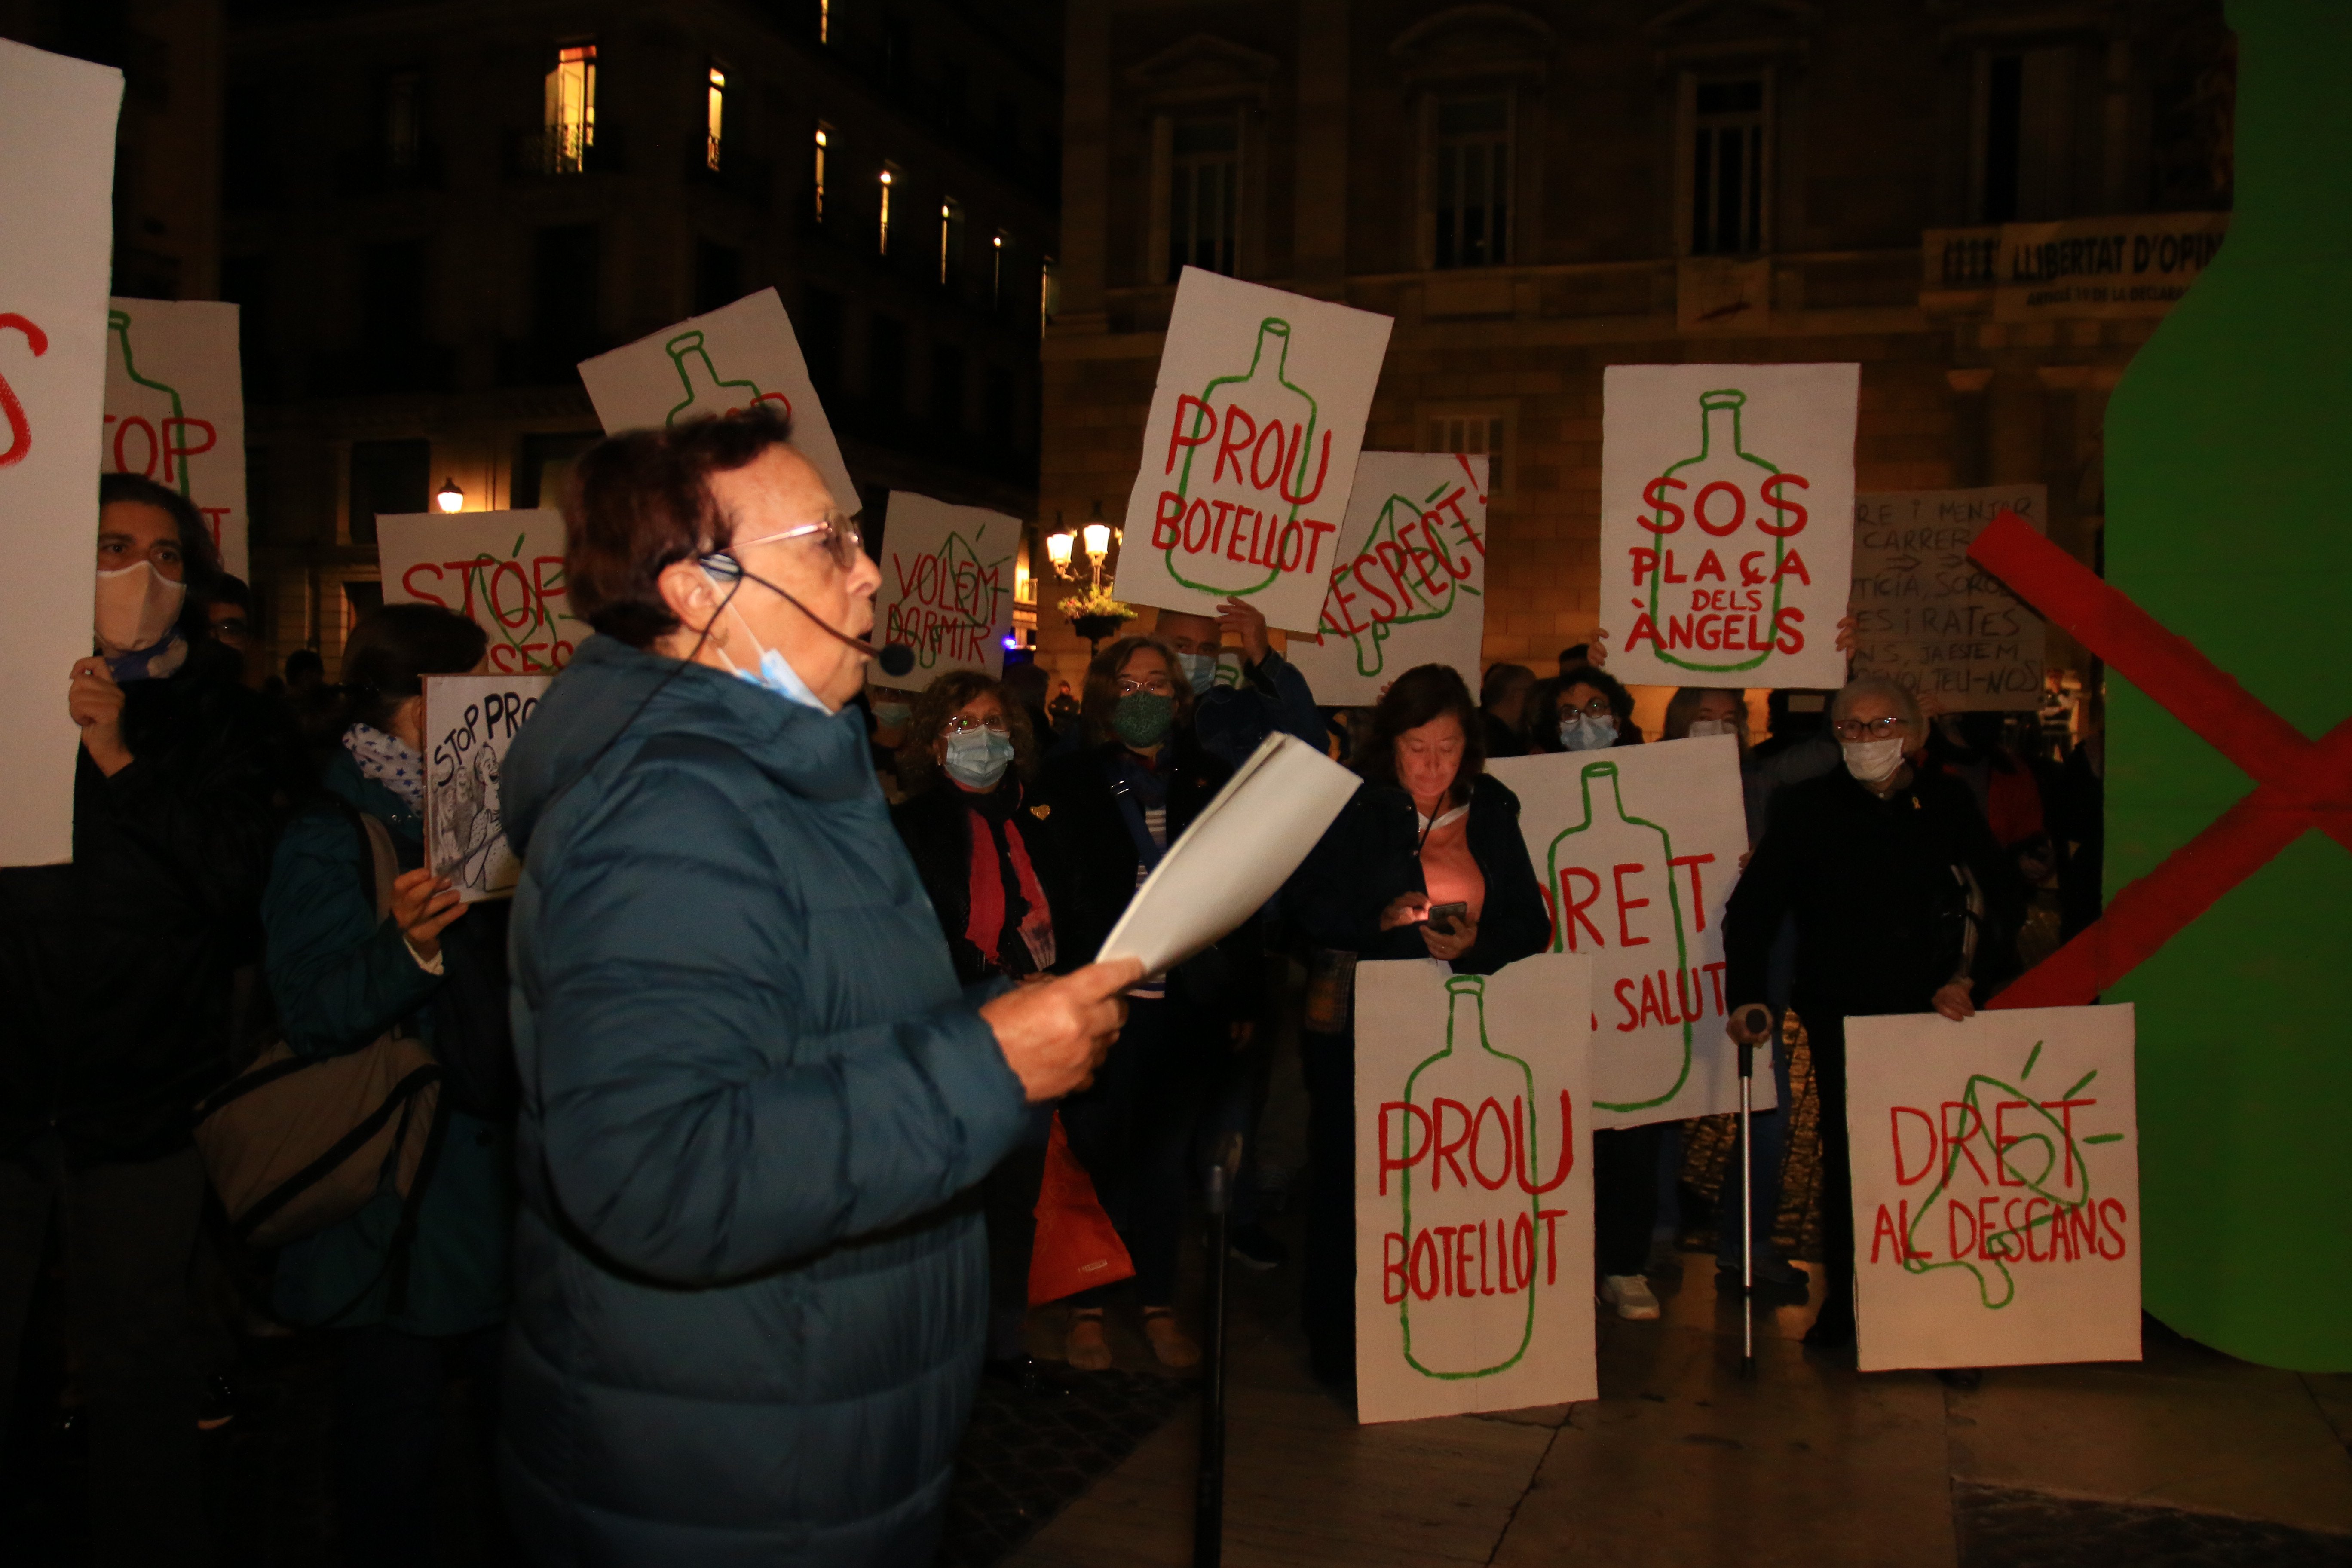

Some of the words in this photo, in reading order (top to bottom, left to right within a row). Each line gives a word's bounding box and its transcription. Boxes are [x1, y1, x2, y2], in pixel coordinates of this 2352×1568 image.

[2013, 236, 2127, 280] LLIBERTAT
[1165, 394, 1332, 505] PROU
[1152, 491, 1336, 573] BOTELLOT
[1637, 473, 1810, 537] SOS
[893, 553, 999, 625] VOLEM
[1629, 547, 1811, 587] PLAÇA
[1691, 589, 1763, 612] DELS
[885, 603, 991, 664] DORMIR
[1625, 598, 1804, 655] ÀNGELS
[1921, 604, 2022, 637] RATES
[433, 704, 479, 787] STOP
[1614, 962, 1726, 1032] SALUT
[1378, 1089, 1574, 1196] PROU
[1890, 1099, 2096, 1190] DRET
[1384, 1210, 1568, 1305] BOTELLOT
[1870, 1199, 1932, 1264] AL
[1948, 1196, 2126, 1263] DESCANS
